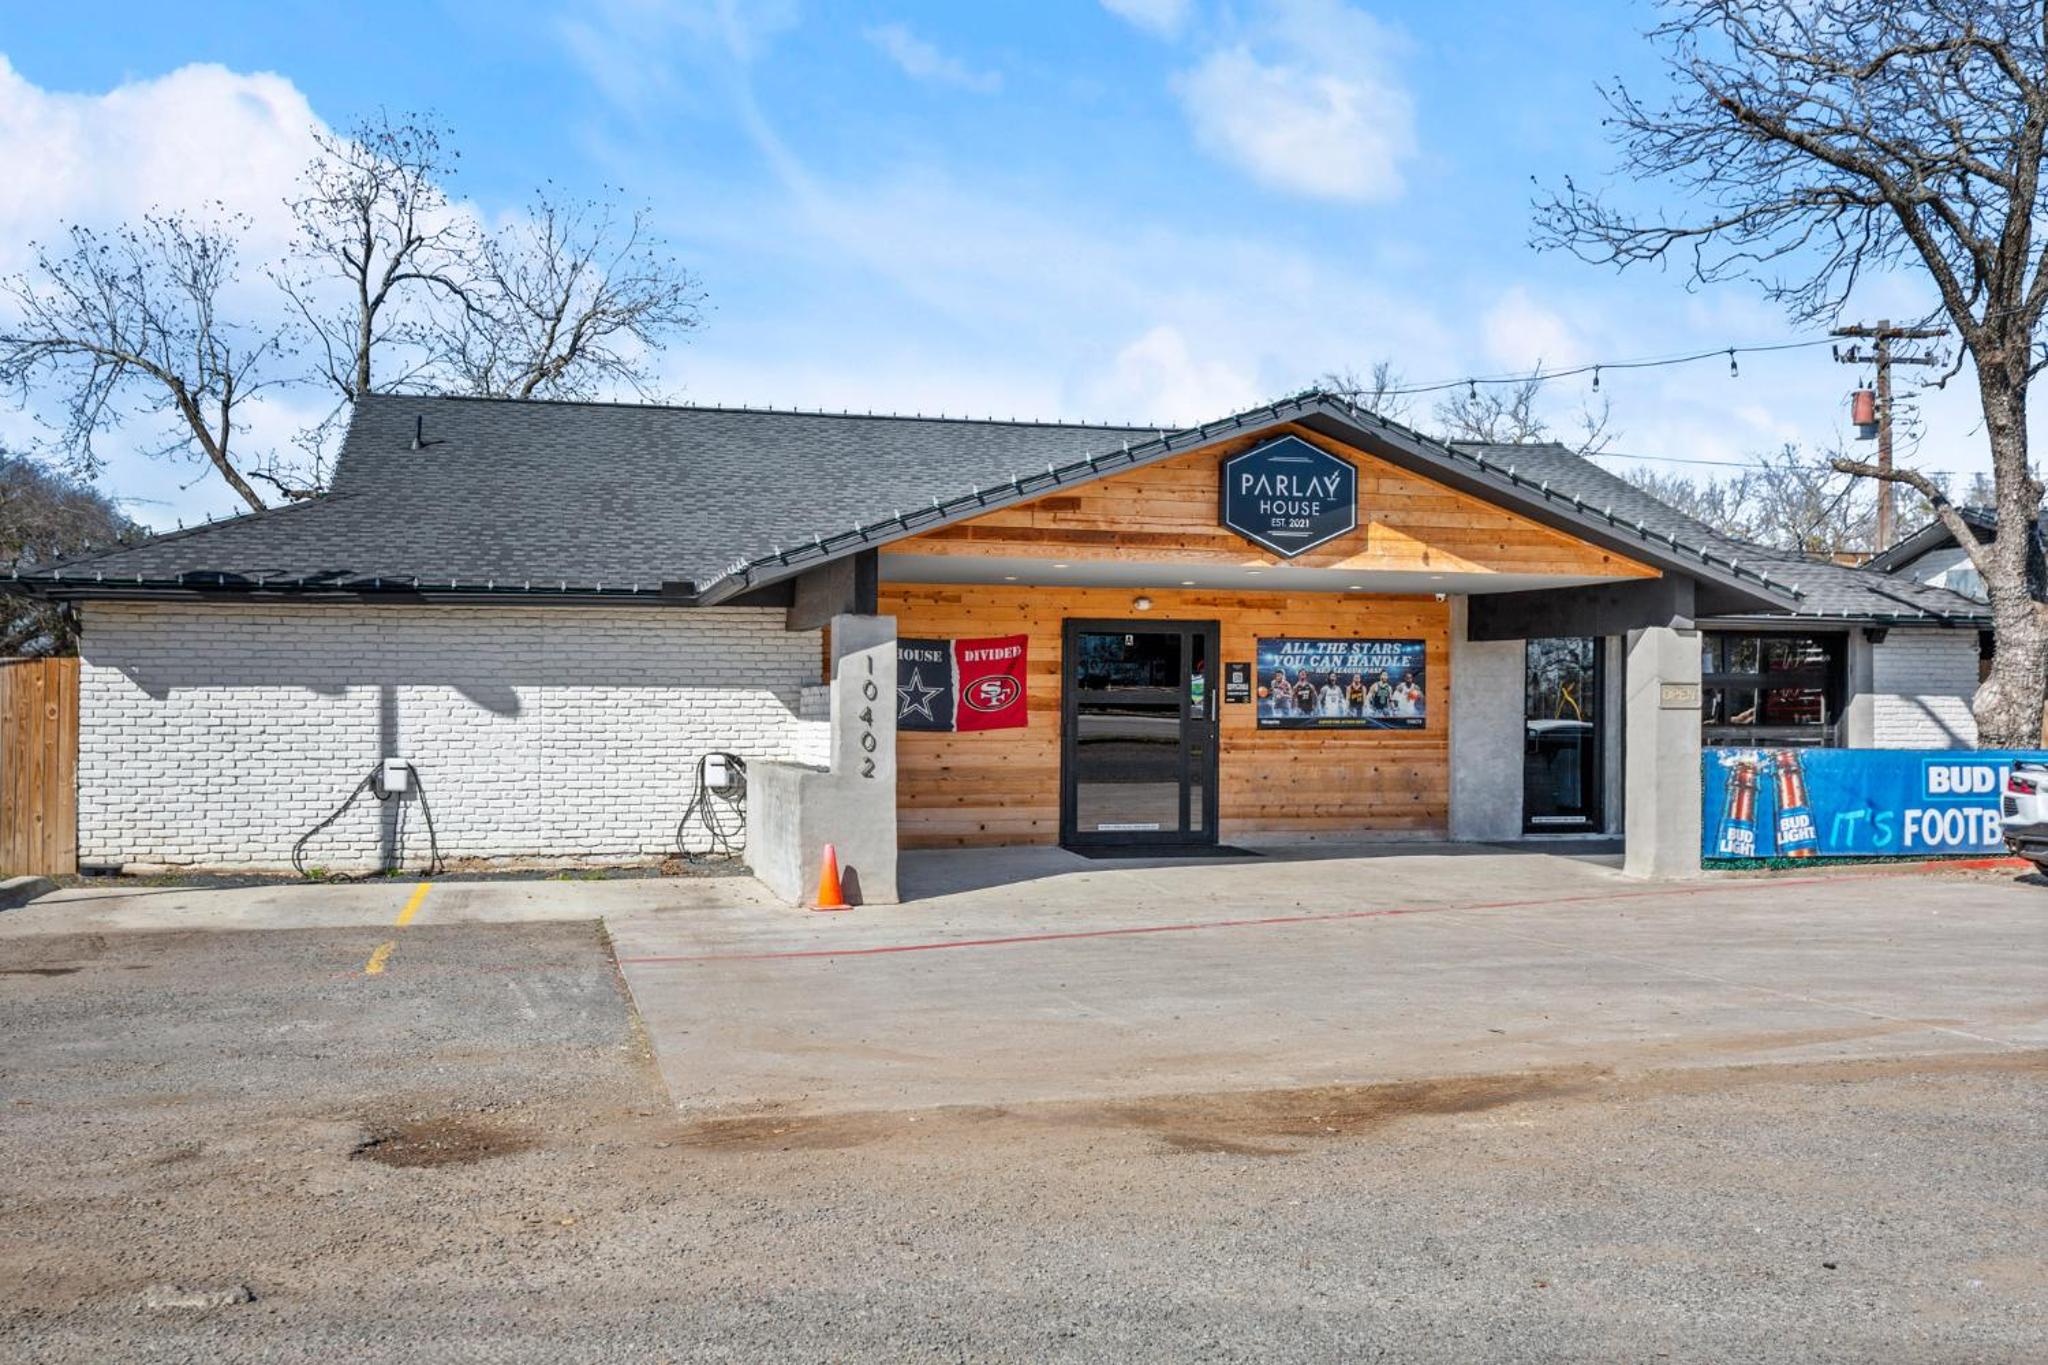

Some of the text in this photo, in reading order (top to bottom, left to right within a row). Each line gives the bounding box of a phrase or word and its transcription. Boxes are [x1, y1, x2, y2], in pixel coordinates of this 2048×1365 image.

[1241, 470, 1341, 501] PARLAY
[1260, 500, 1320, 515] HOUSE
[1271, 518, 1310, 528] EST. 2021
[964, 645, 1022, 662] DIVIDED
[1281, 643, 1402, 654] ALL THE STARS
[1274, 655, 1412, 667] YOU CAN HANDLE
[1928, 766, 1995, 794] BUD
[1780, 815, 1810, 831] BUD
[1830, 807, 2002, 847] IT'S FOOTB
[1727, 827, 1754, 843] BUD
[1777, 826, 1817, 845] LIGHT
[1720, 839, 1756, 857] LIGHT
